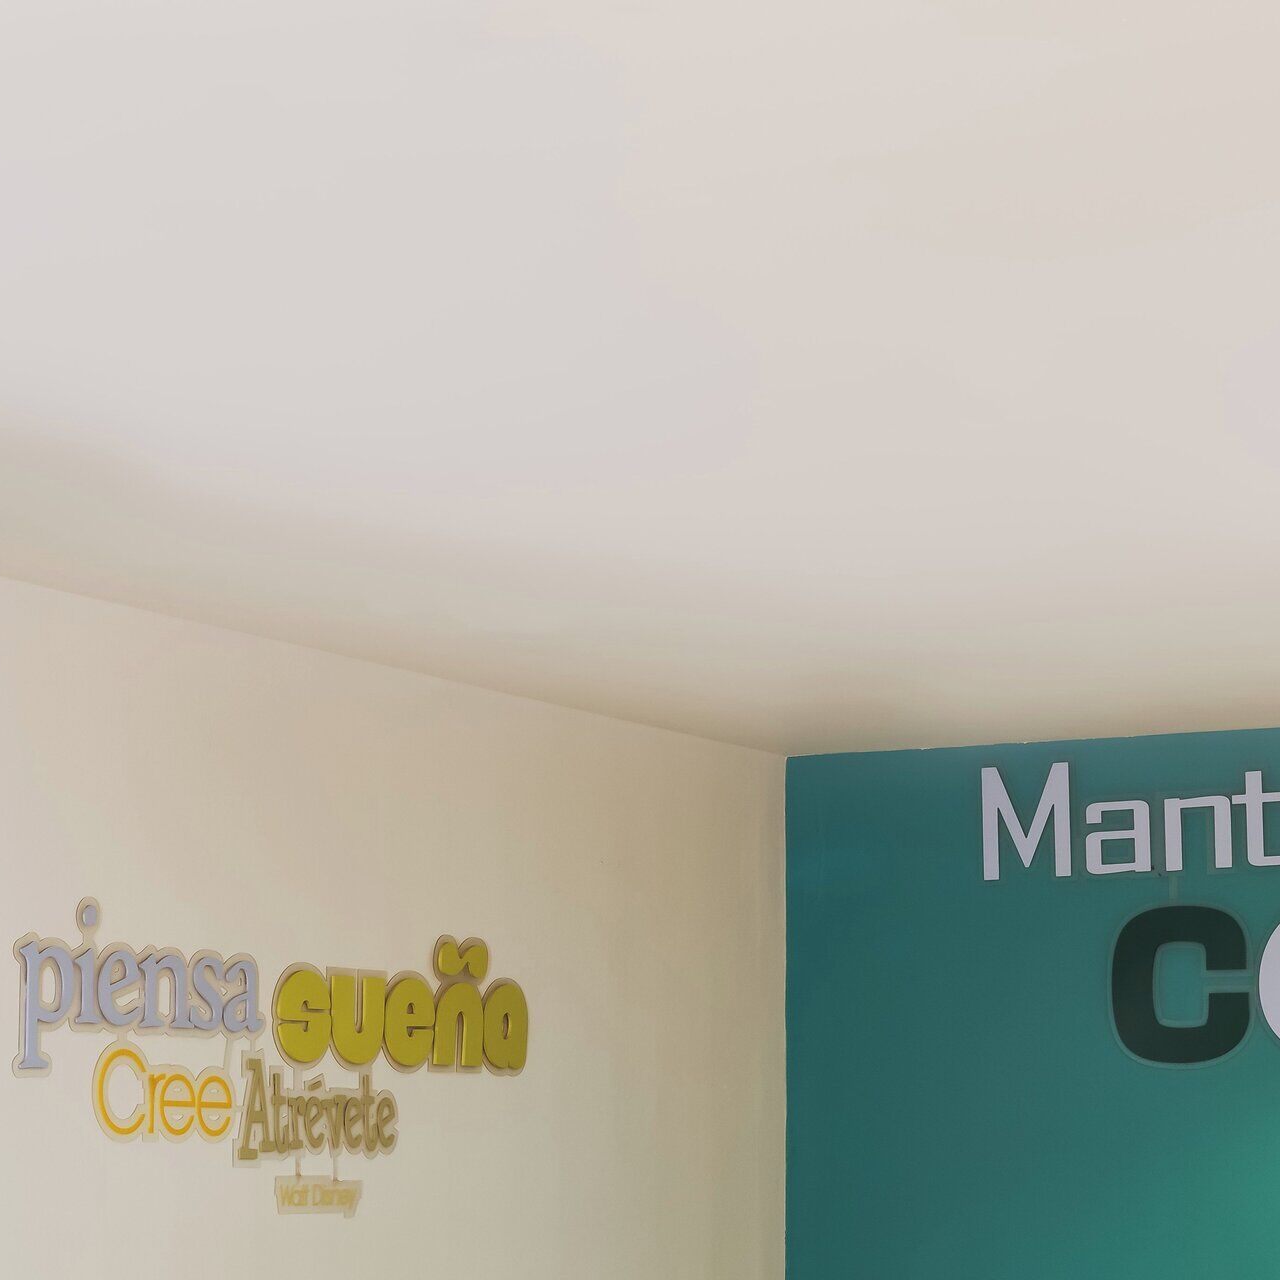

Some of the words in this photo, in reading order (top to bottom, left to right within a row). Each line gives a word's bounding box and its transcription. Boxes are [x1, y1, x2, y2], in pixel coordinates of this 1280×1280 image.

[17, 904, 265, 1069] piensa
[276, 940, 527, 1070] sueña
[97, 1048, 232, 1136] Cree
[238, 1057, 396, 1160] Atrévete
